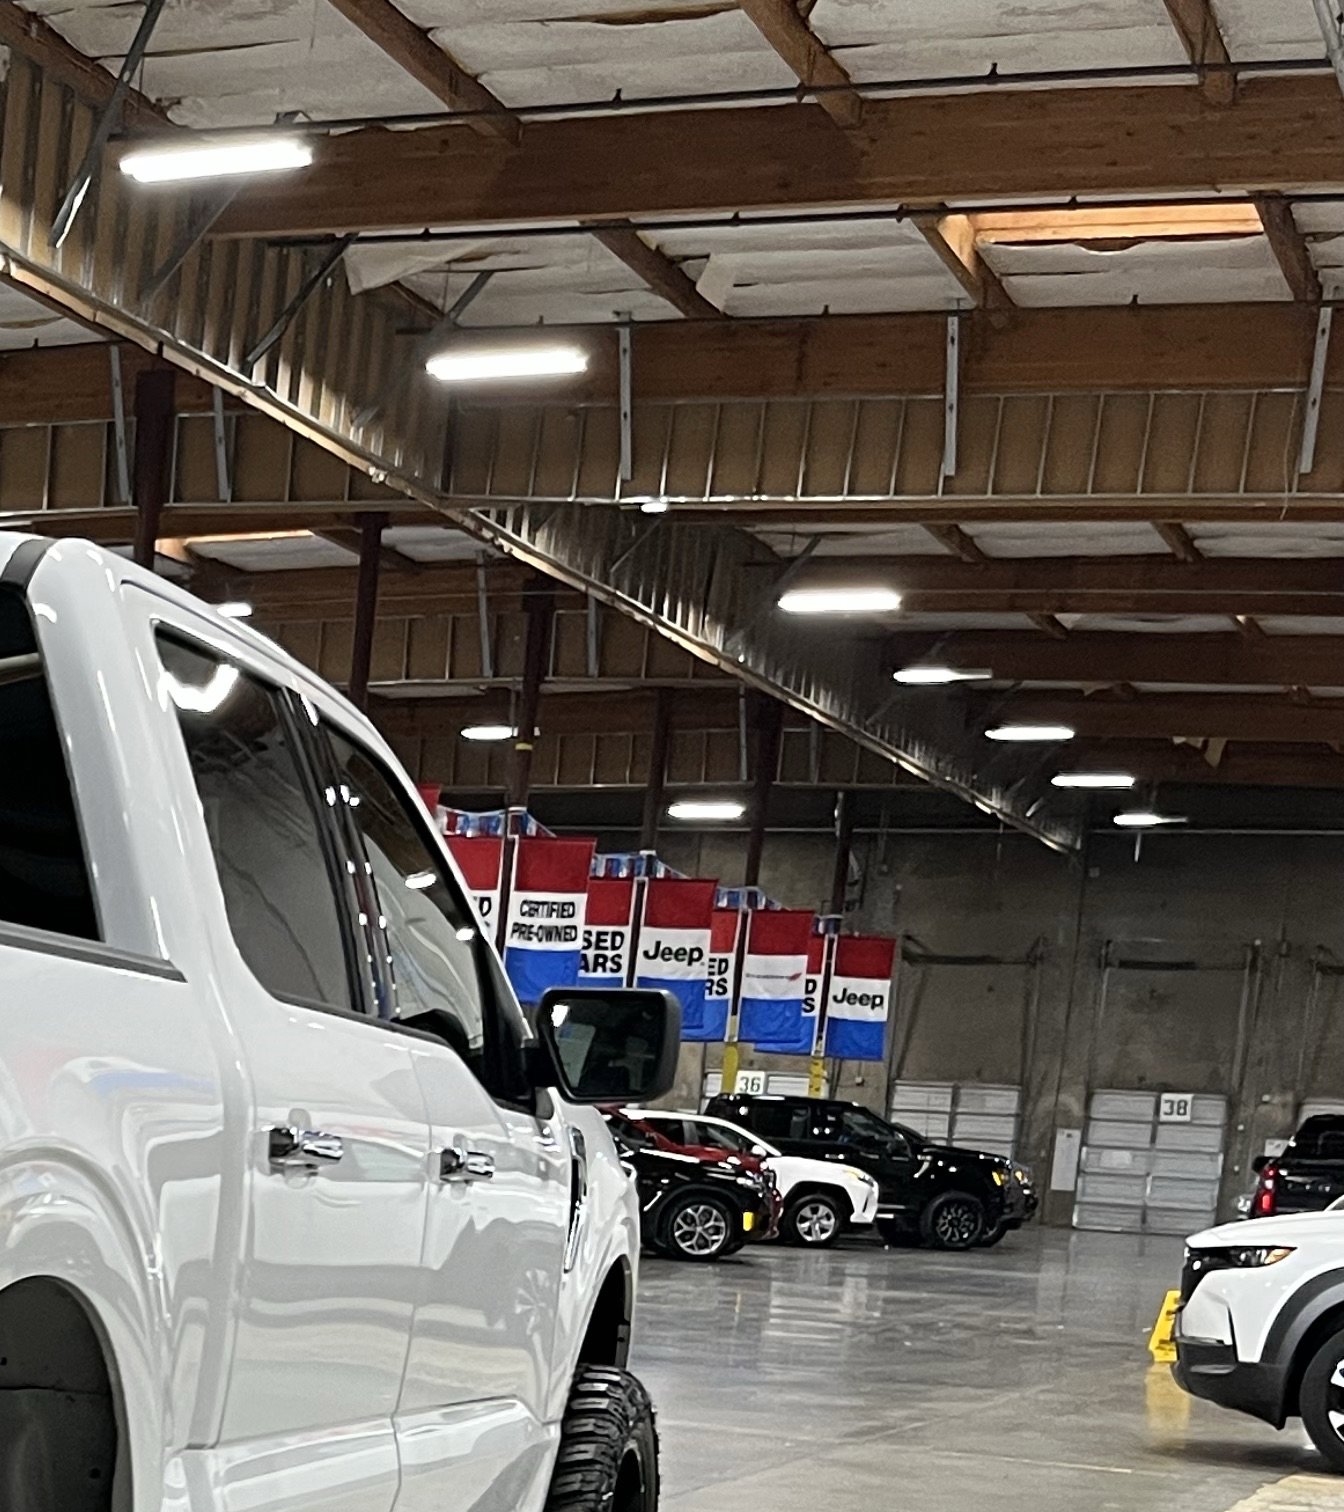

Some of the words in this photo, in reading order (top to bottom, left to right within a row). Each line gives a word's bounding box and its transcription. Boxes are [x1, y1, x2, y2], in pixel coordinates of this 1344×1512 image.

[520, 899, 576, 919] CERTIFIED
[511, 922, 578, 943] PRE-OWNED
[582, 930, 625, 951] SED
[579, 953, 623, 974] ARS
[643, 940, 704, 967] Jeep
[832, 987, 884, 1011] Jeep
[740, 1076, 761, 1093] 36
[1163, 1099, 1188, 1116] 38
